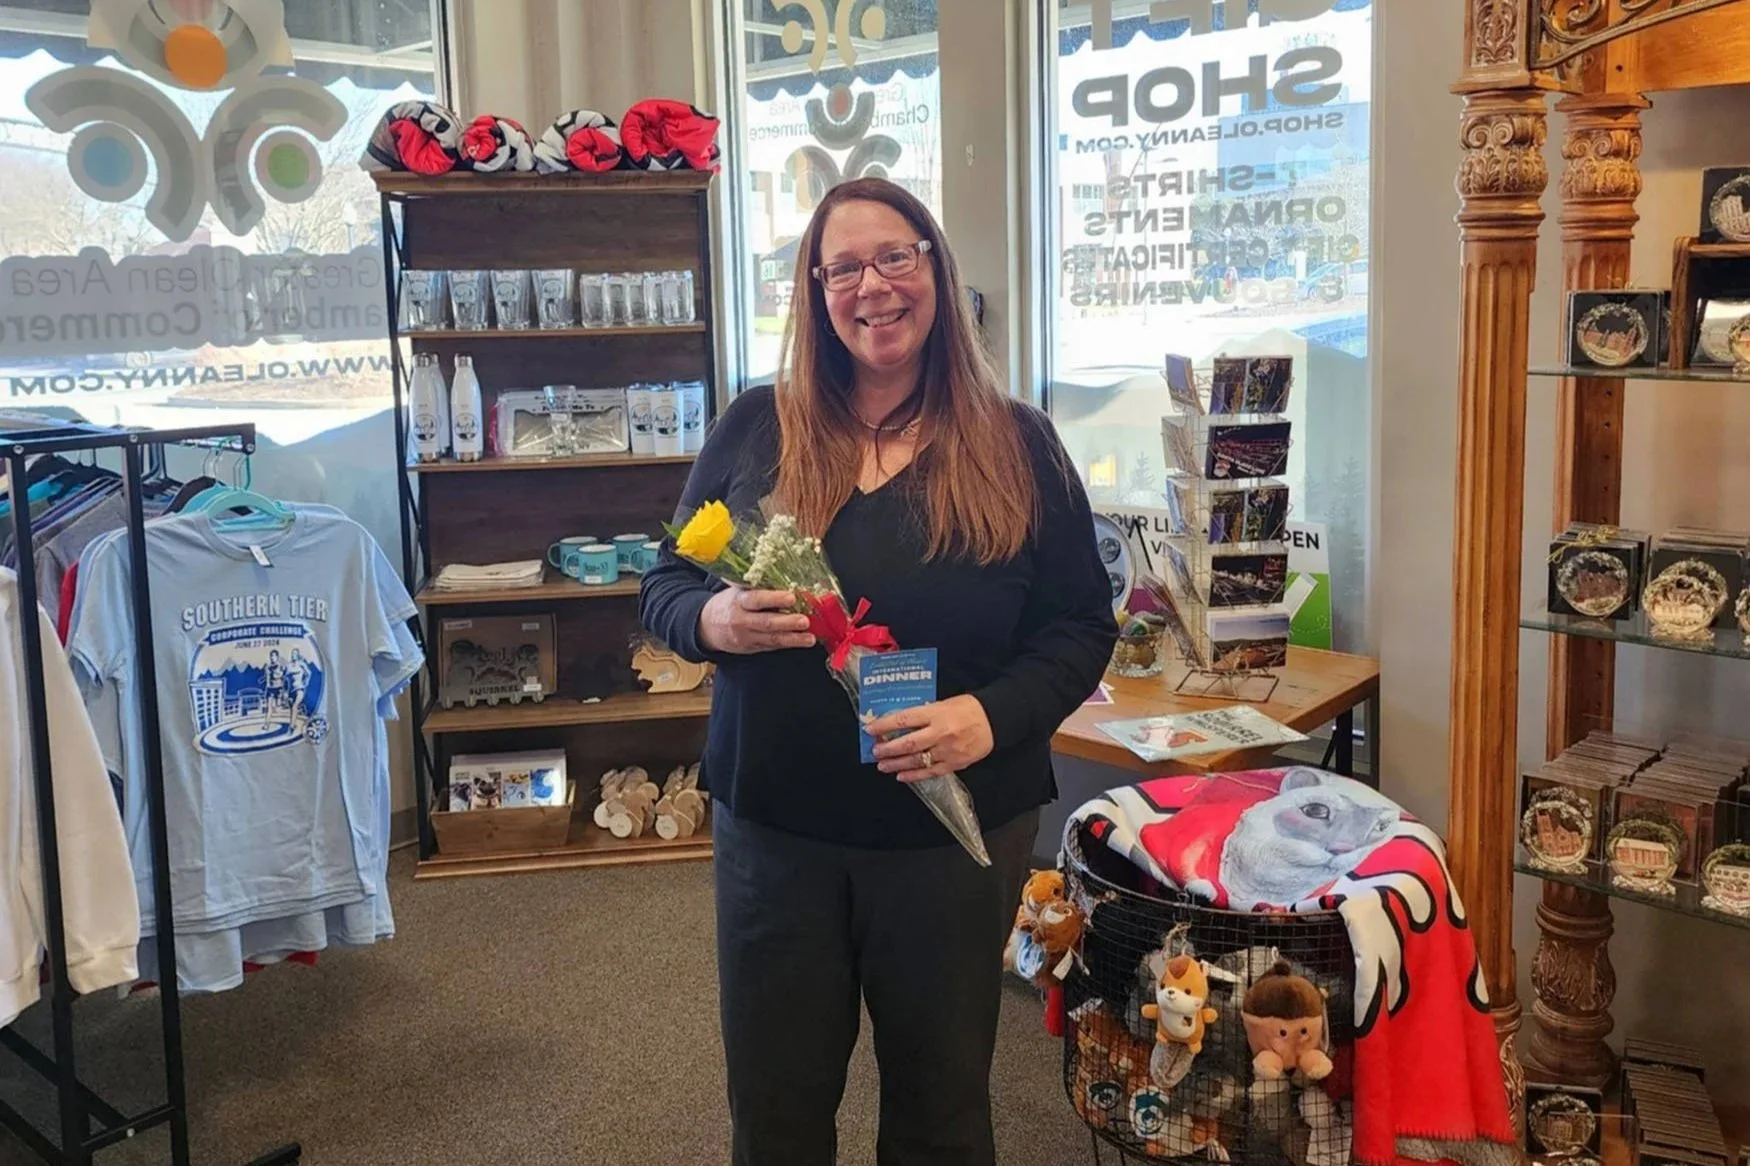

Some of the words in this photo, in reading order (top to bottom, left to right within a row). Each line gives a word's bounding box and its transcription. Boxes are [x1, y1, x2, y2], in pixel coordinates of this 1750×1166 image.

[1106, 511, 1149, 532] OUR
[1279, 529, 1320, 550] PEN
[181, 593, 281, 632] SOUTHERN
[287, 594, 330, 623] TIER
[210, 625, 258, 642] CORPORATE
[259, 624, 304, 637] CHALLENGE
[863, 671, 933, 686] DINNER
